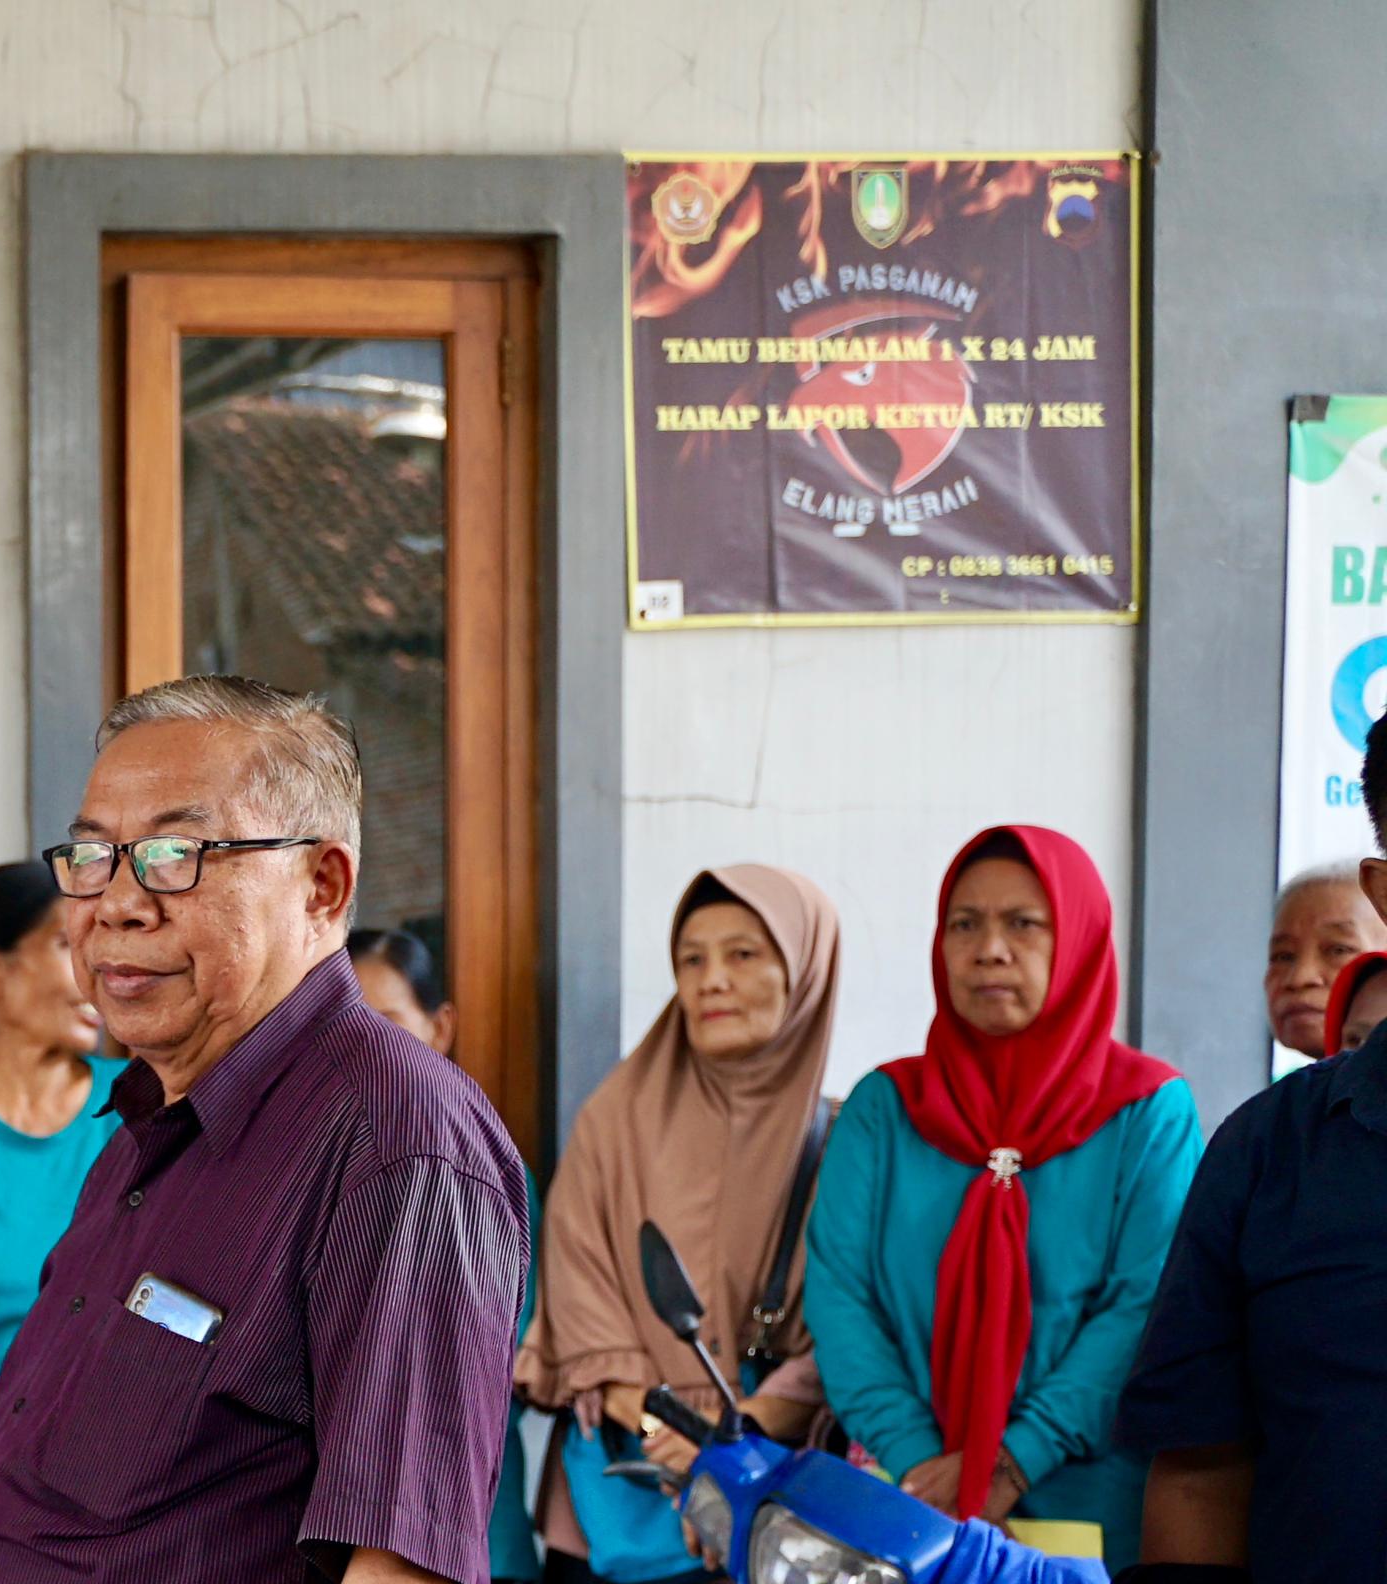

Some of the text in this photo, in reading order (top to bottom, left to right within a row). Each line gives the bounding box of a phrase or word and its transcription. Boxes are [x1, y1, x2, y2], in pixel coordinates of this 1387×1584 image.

[662, 336, 1097, 363] TAMU BERMALAM 1 X 24 JAM
[655, 405, 761, 431] HARAP
[766, 404, 871, 430] LAPOR
[875, 404, 979, 428] KETUA
[1040, 403, 1105, 427] KSK
[782, 476, 979, 524] ELANG MERAH
